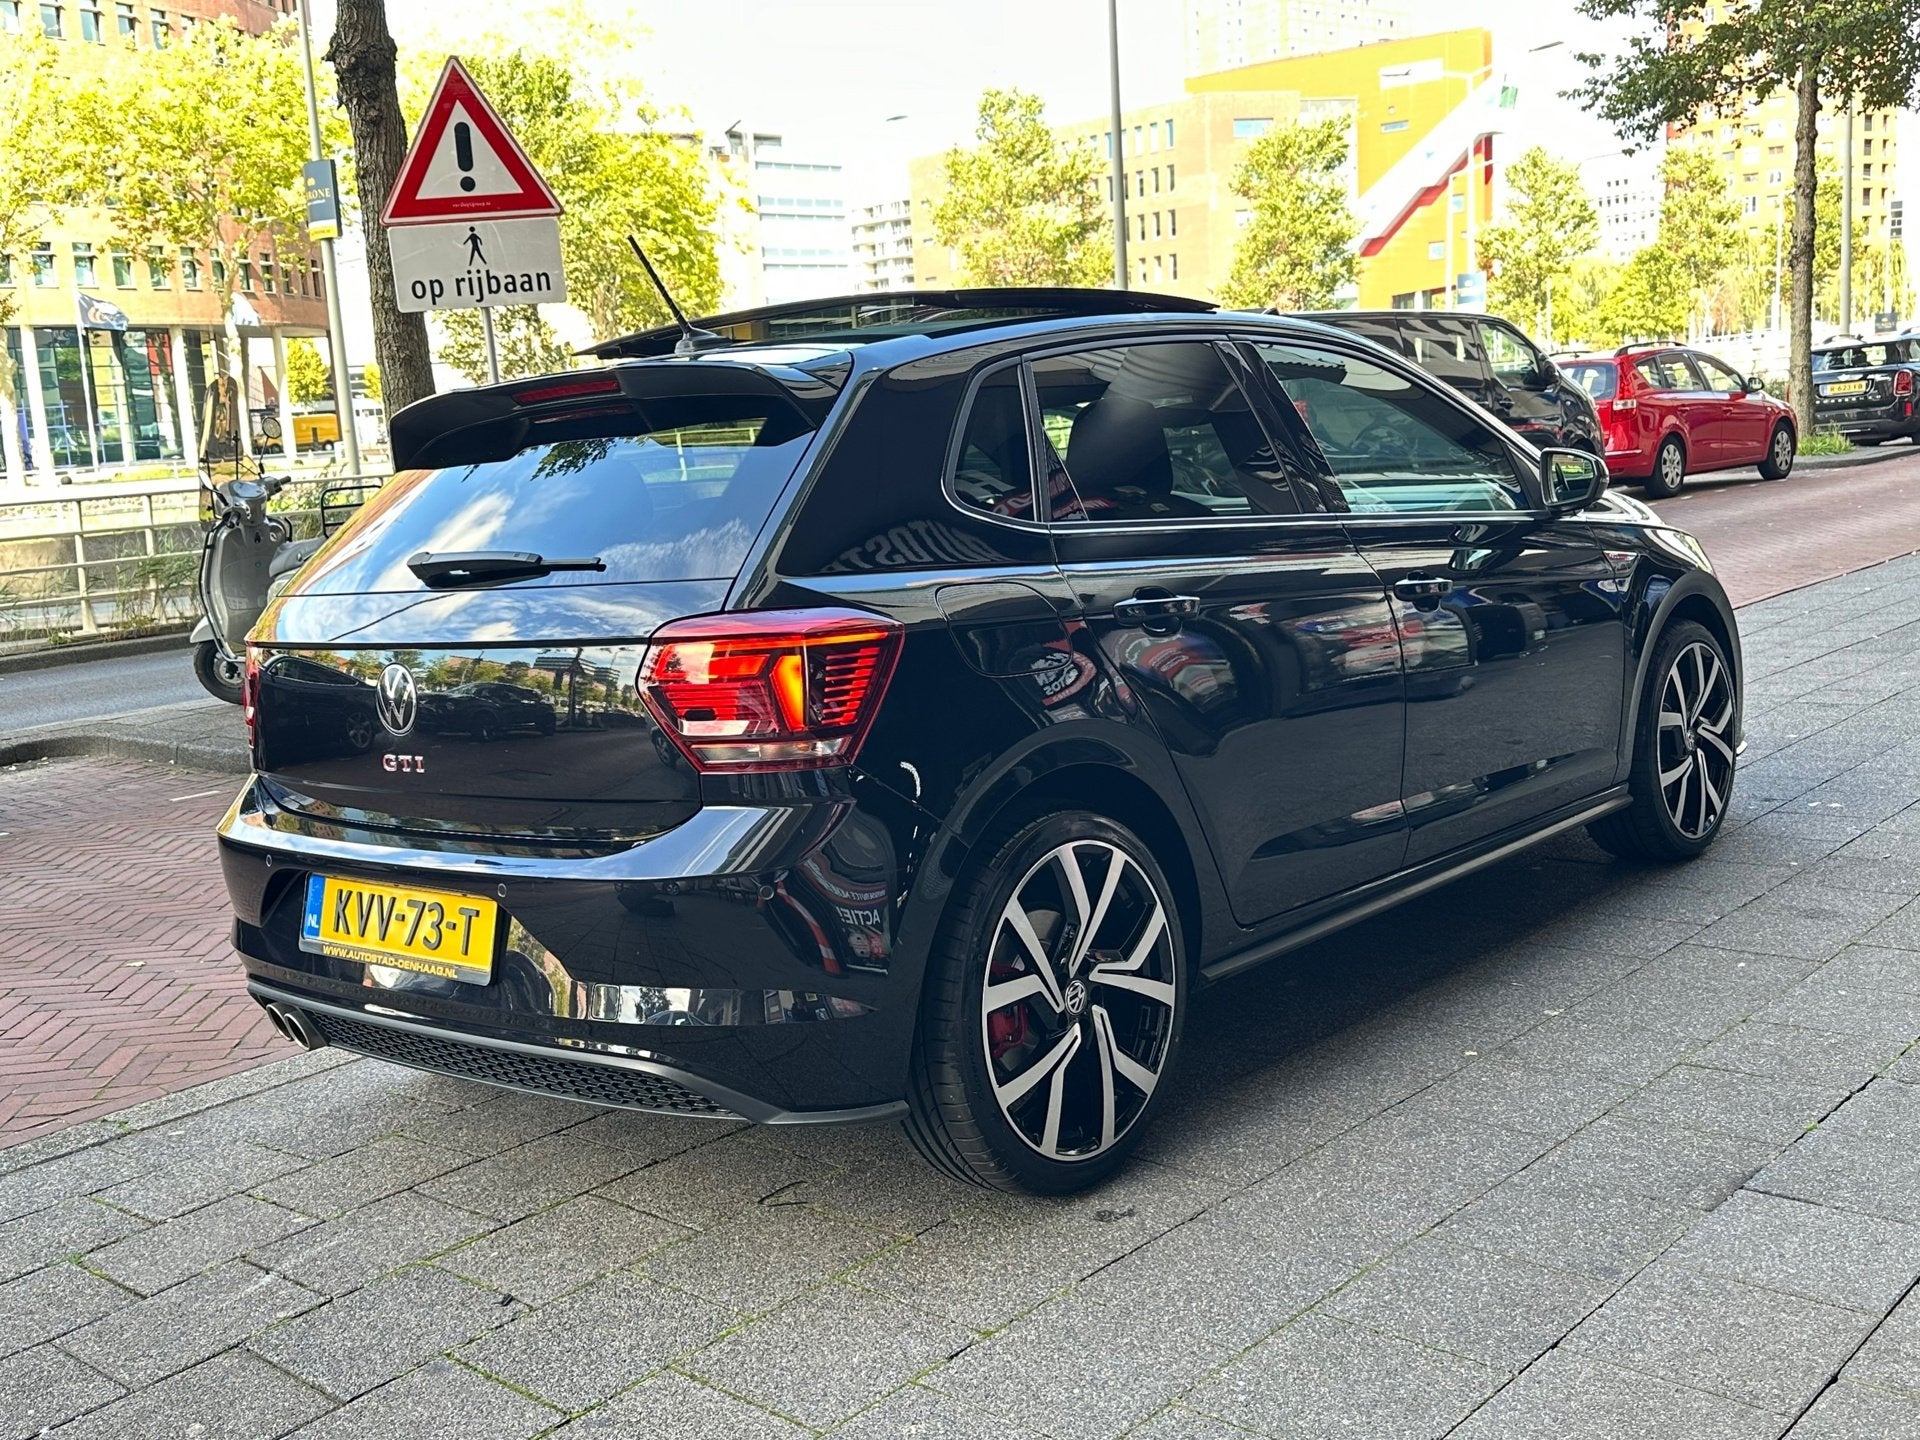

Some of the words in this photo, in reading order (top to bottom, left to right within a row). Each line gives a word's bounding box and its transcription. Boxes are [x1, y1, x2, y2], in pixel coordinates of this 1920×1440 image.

[411, 278, 444, 305] op
[455, 269, 551, 303] rijbaan
[382, 753, 425, 773] GTI
[307, 913, 320, 929] NL
[333, 888, 480, 956] KVV-73-T
[322, 944, 458, 979] WWW.AUTOSTAD-DENHAAG.NL
